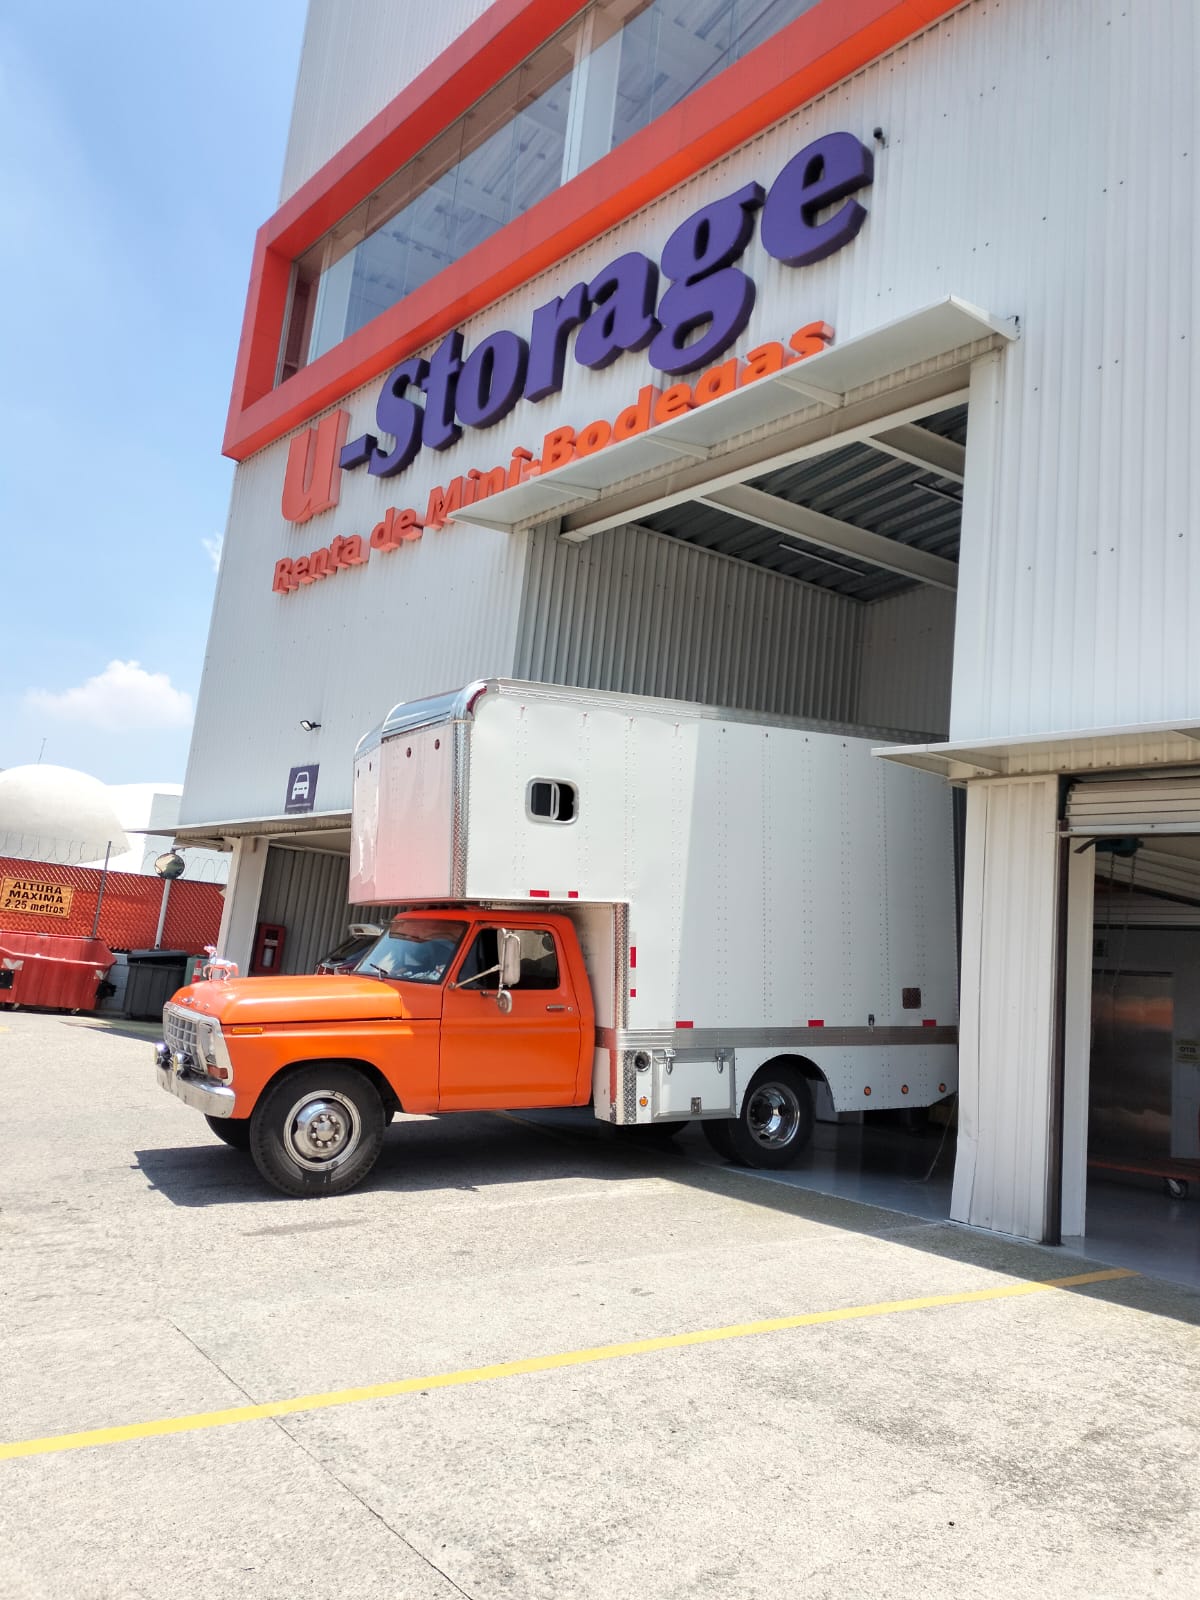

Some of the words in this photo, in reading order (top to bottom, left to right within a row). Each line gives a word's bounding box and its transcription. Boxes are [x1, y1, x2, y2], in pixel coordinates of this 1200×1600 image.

[272, 534, 370, 594] Renta
[370, 507, 423, 552] de
[13, 881, 62, 894] ALTURA
[9, 890, 63, 903] MAXIMA
[4, 898, 28, 909] 2.25
[30, 903, 65, 914] metros
